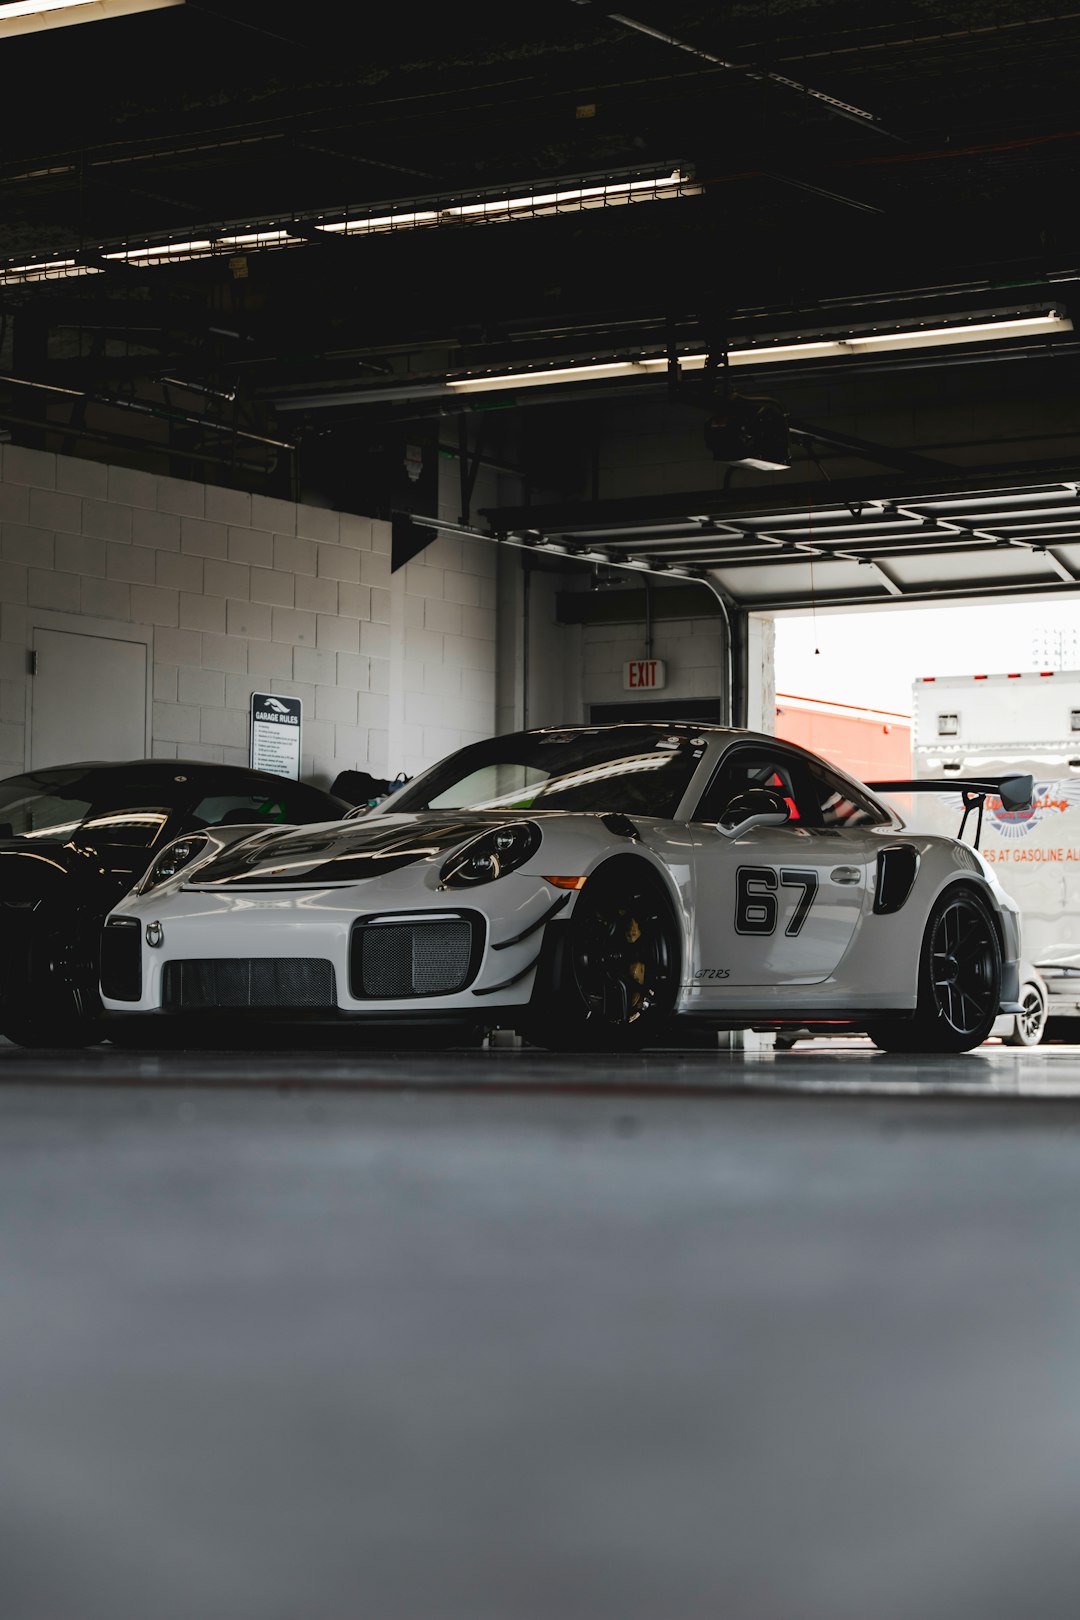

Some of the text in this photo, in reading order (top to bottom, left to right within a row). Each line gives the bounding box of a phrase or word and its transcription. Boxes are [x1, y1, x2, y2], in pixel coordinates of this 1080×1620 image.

[629, 661, 657, 688] EXIT
[255, 711, 298, 724] GARAGE RULES
[998, 849, 1010, 861] AT
[1013, 848, 1063, 862] GASOLINE
[1066, 847, 1080, 861] AL
[734, 865, 819, 937] 67
